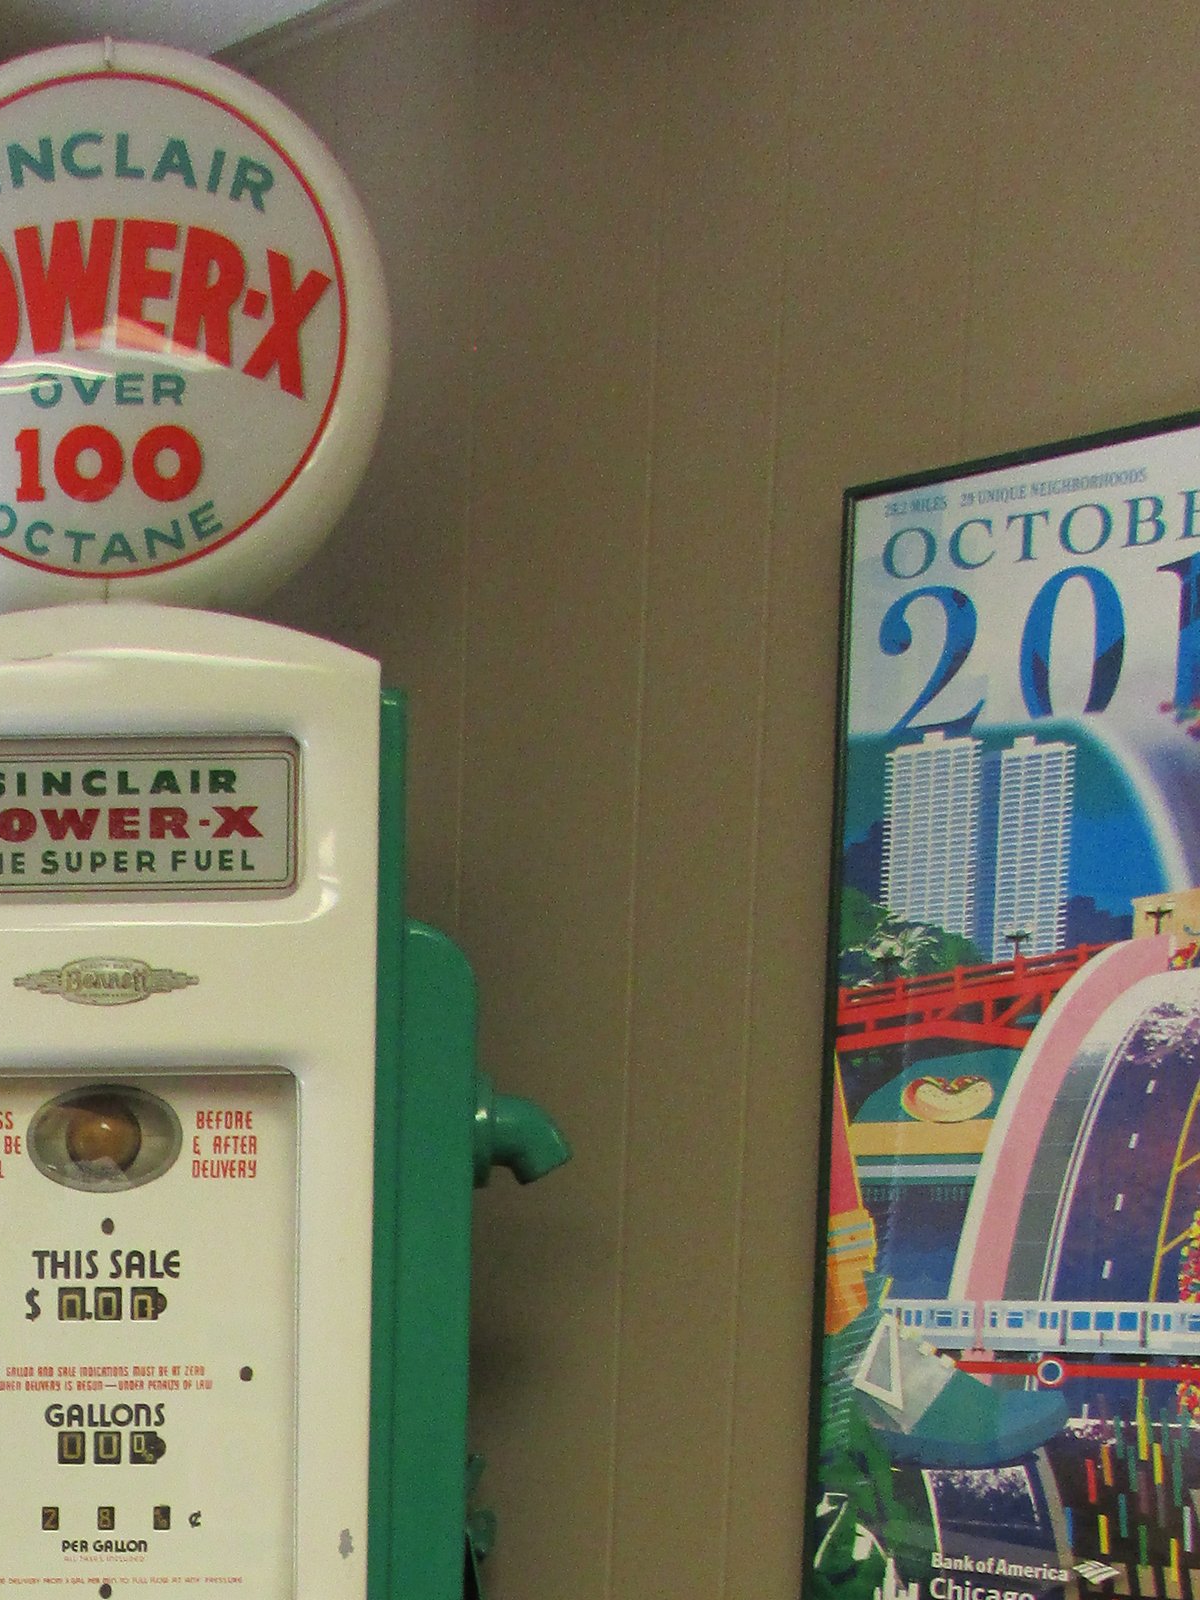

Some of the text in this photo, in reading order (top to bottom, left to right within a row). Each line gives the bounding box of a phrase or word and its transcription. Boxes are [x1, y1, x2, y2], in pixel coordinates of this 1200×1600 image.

[30, 372, 187, 409] OVER
[13, 424, 203, 503] 100
[41, 849, 157, 876] SUPER
[171, 849, 256, 873] FUEL
[196, 1111, 253, 1130] BEFORE
[4, 1135, 22, 1155] BE
[213, 1135, 258, 1155] AFTER
[191, 1159, 258, 1179] DELIVERY
[31, 1249, 180, 1280] THIS SALE
[64, 1381, 73, 1391] IS
[45, 1403, 165, 1428] GALLONS
[61, 1540, 148, 1553] PER GALLON
[931, 1552, 1071, 1582] Bank of America
